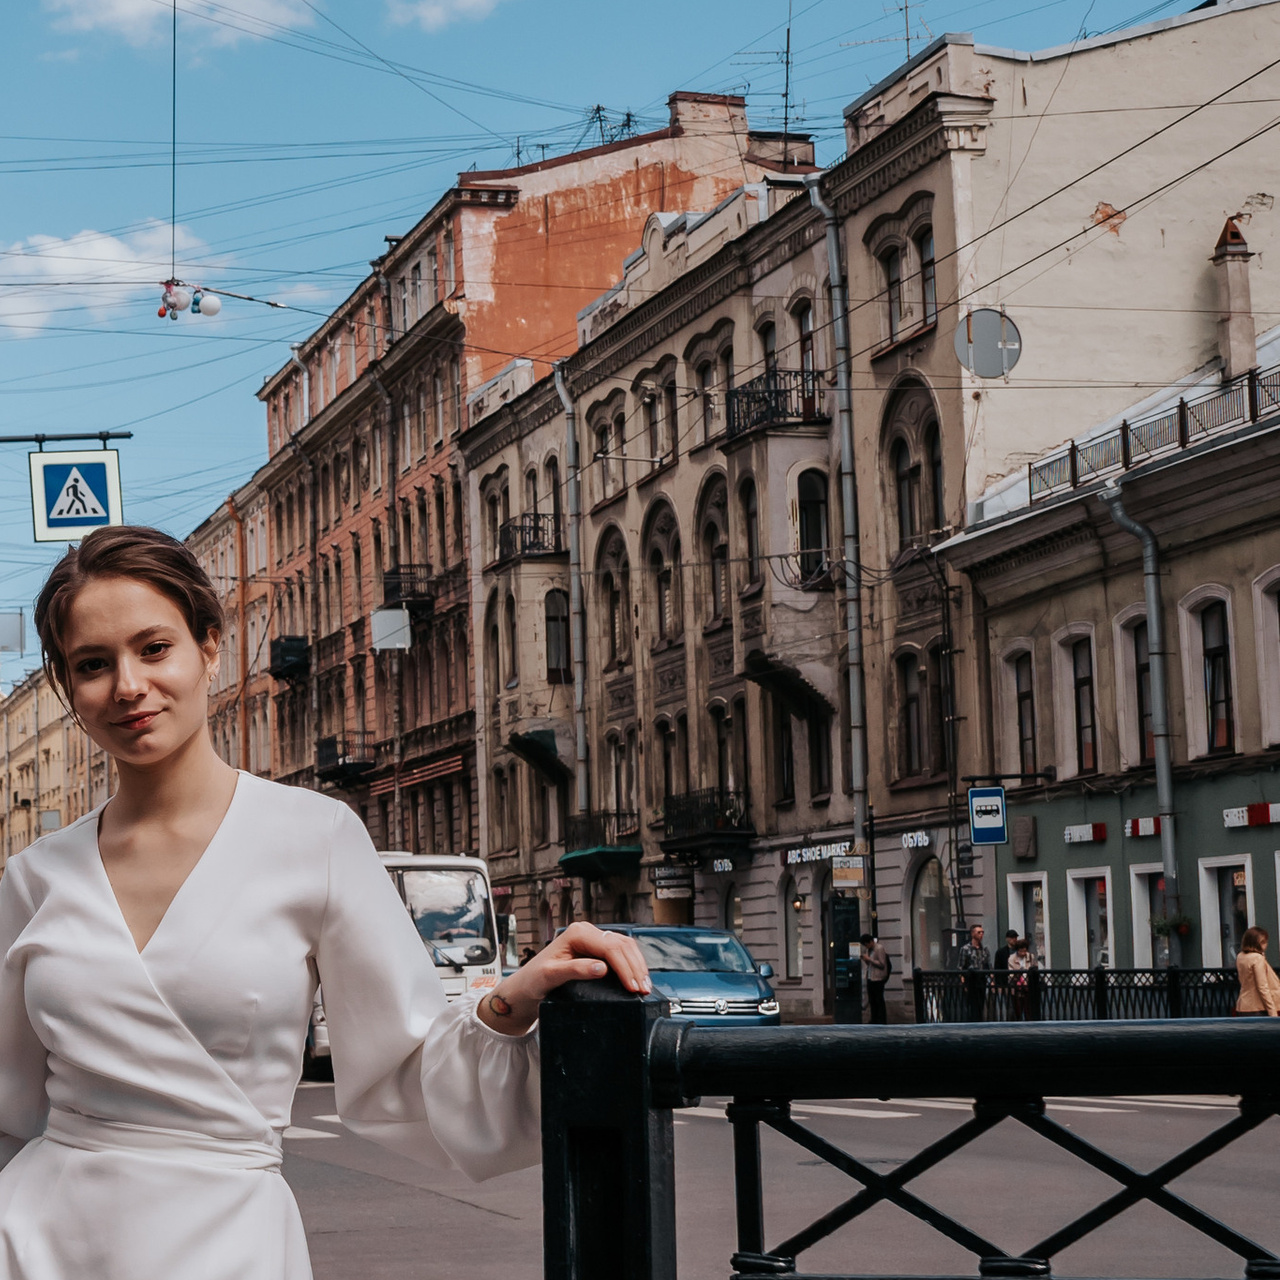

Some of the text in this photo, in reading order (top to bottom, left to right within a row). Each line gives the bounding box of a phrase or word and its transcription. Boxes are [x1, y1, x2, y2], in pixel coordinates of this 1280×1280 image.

[901, 831, 930, 849] ОБУВЬ
[787, 841, 851, 865] ABC SHOE MARKET
